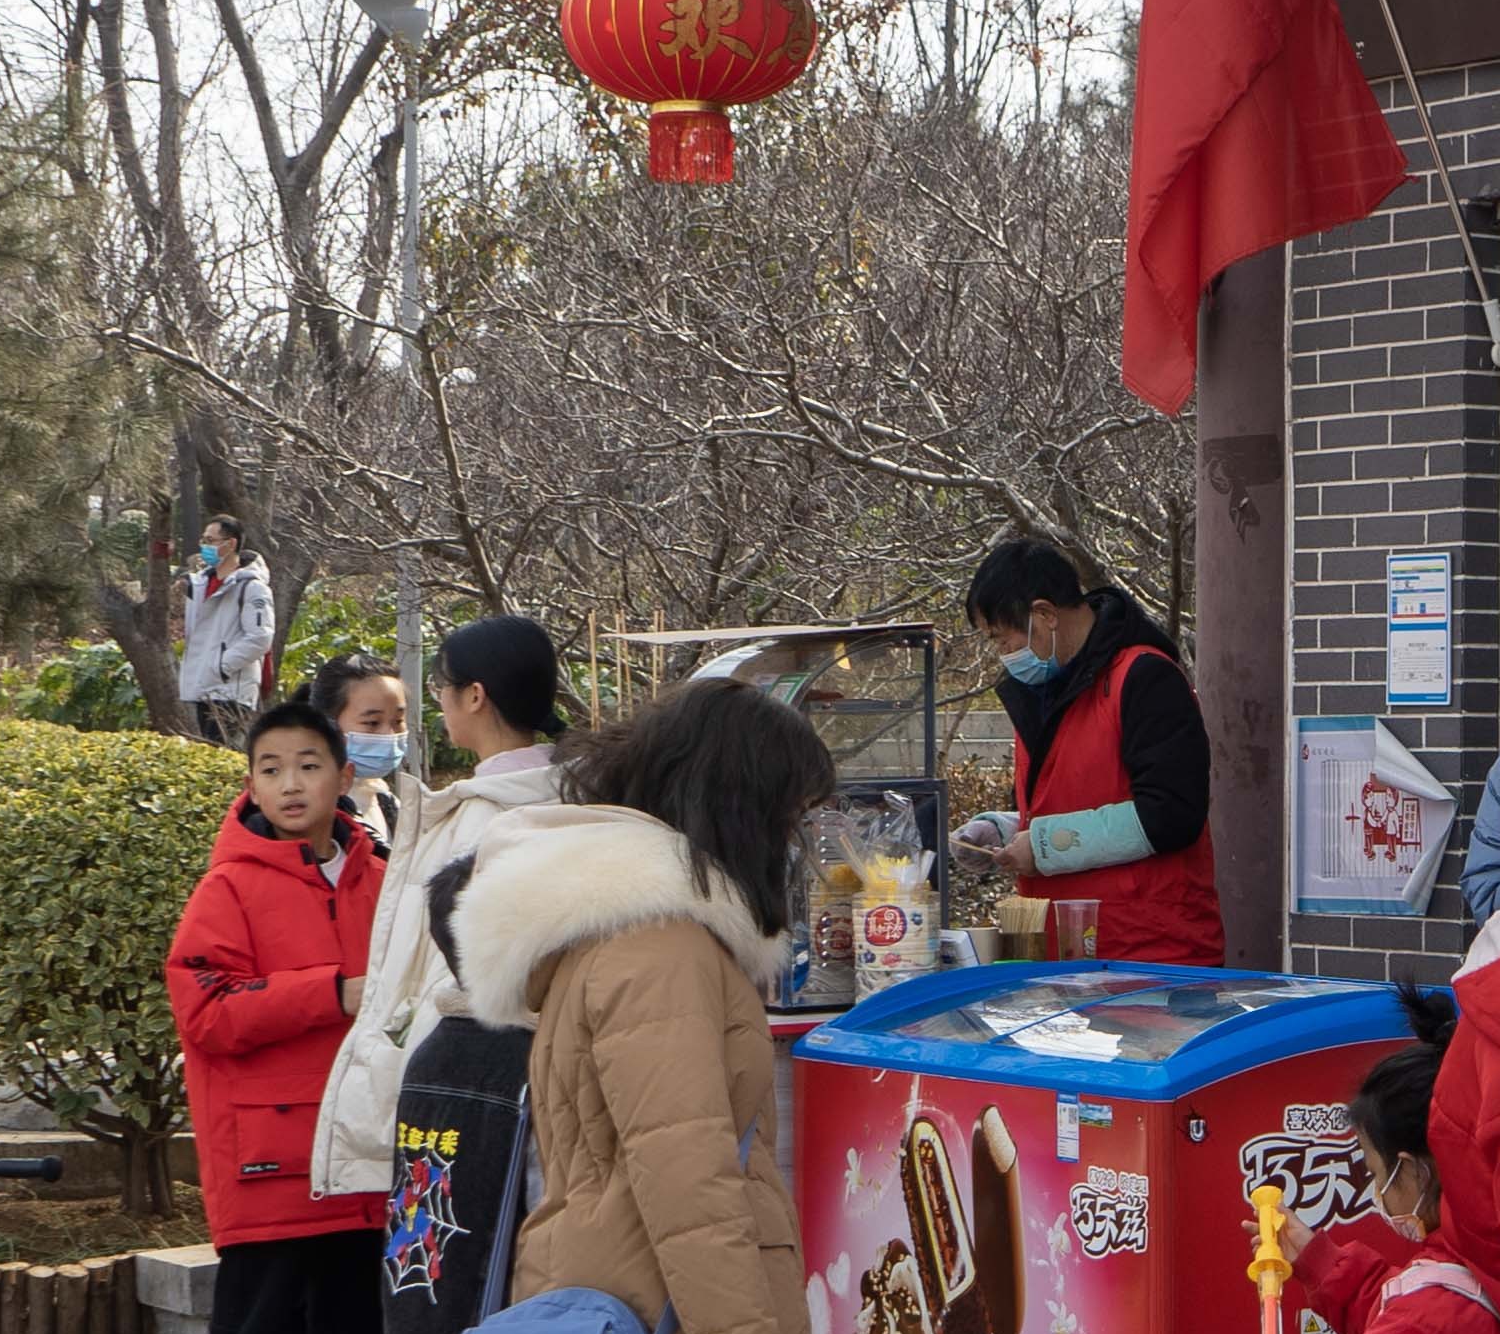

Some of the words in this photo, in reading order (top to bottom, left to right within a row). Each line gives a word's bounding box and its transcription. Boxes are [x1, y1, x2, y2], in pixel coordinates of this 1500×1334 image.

[1071, 1183, 1148, 1258] 巧乐兹
[1241, 1134, 1378, 1229] 巧乐
